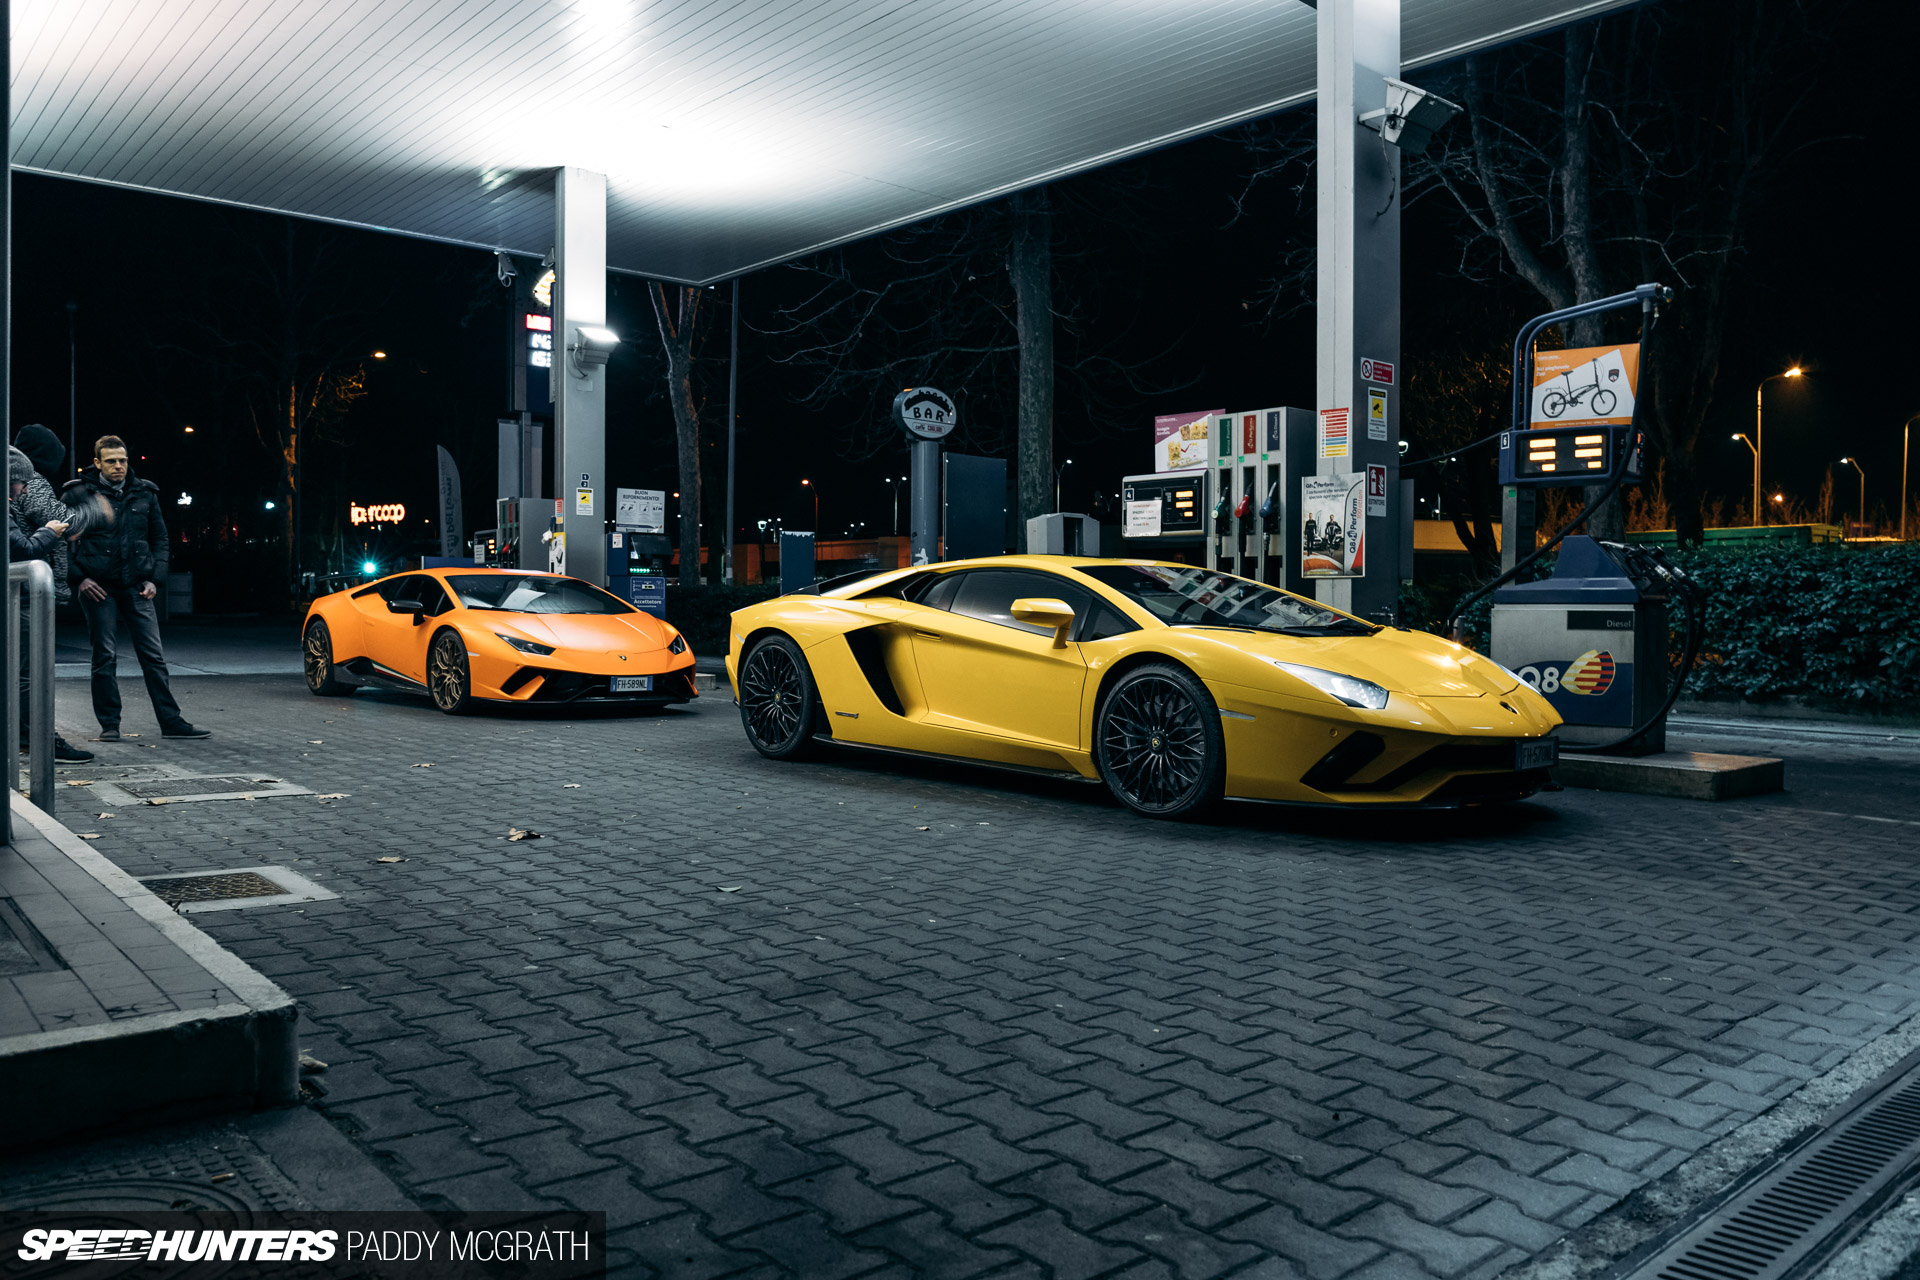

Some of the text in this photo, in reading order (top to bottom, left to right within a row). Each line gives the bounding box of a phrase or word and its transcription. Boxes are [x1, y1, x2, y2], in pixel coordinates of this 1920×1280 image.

[914, 407, 944, 422] BAR
[1349, 541, 1356, 553] Q8
[1607, 619, 1631, 627] Diesel
[1518, 666, 1559, 693] Q8
